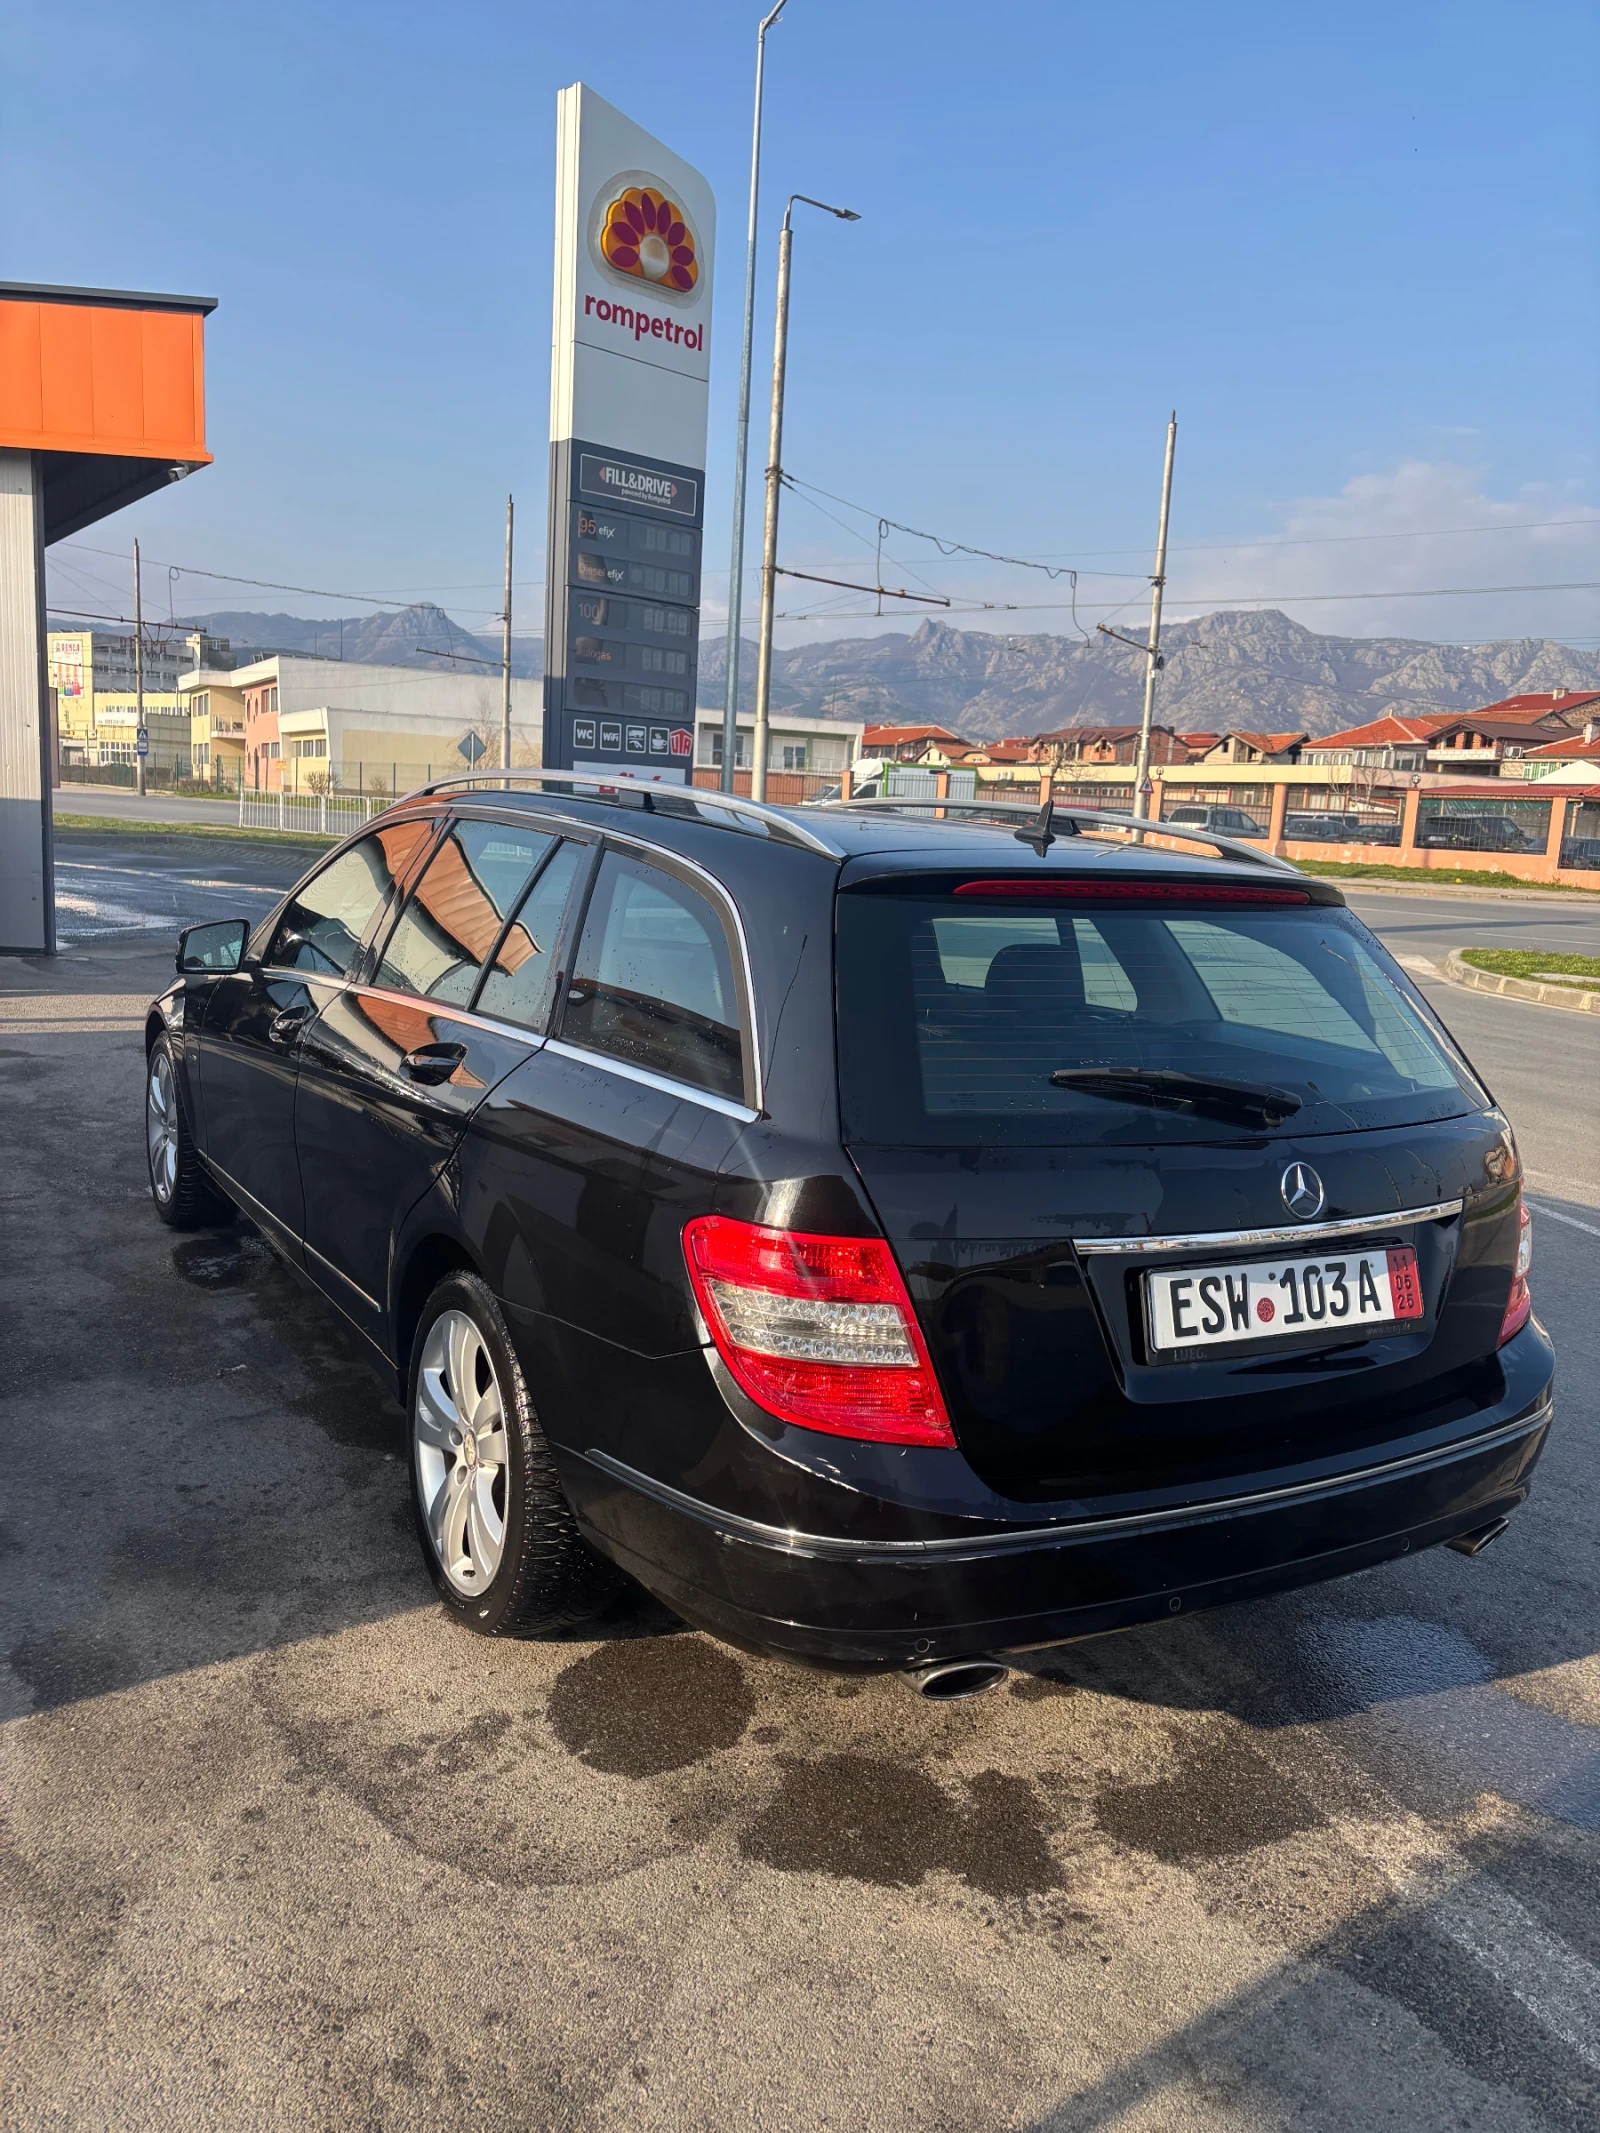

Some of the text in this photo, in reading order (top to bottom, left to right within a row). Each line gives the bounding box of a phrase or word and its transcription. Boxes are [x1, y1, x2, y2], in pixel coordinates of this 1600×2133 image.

[584, 295, 703, 351] rompetrol
[605, 466, 671, 498] FILL&DRIVE
[580, 517, 616, 539] 95 efix
[579, 563, 624, 582] Diesel efix
[578, 603, 600, 619] 100
[576, 645, 611, 662] Autogas
[576, 728, 619, 742] WC WiFi
[670, 728, 693, 756] UTA
[1393, 1255, 1408, 1271] 11
[1395, 1274, 1412, 1291] 05
[1169, 1259, 1382, 1338] ESW 103 A
[1397, 1293, 1414, 1310] 25
